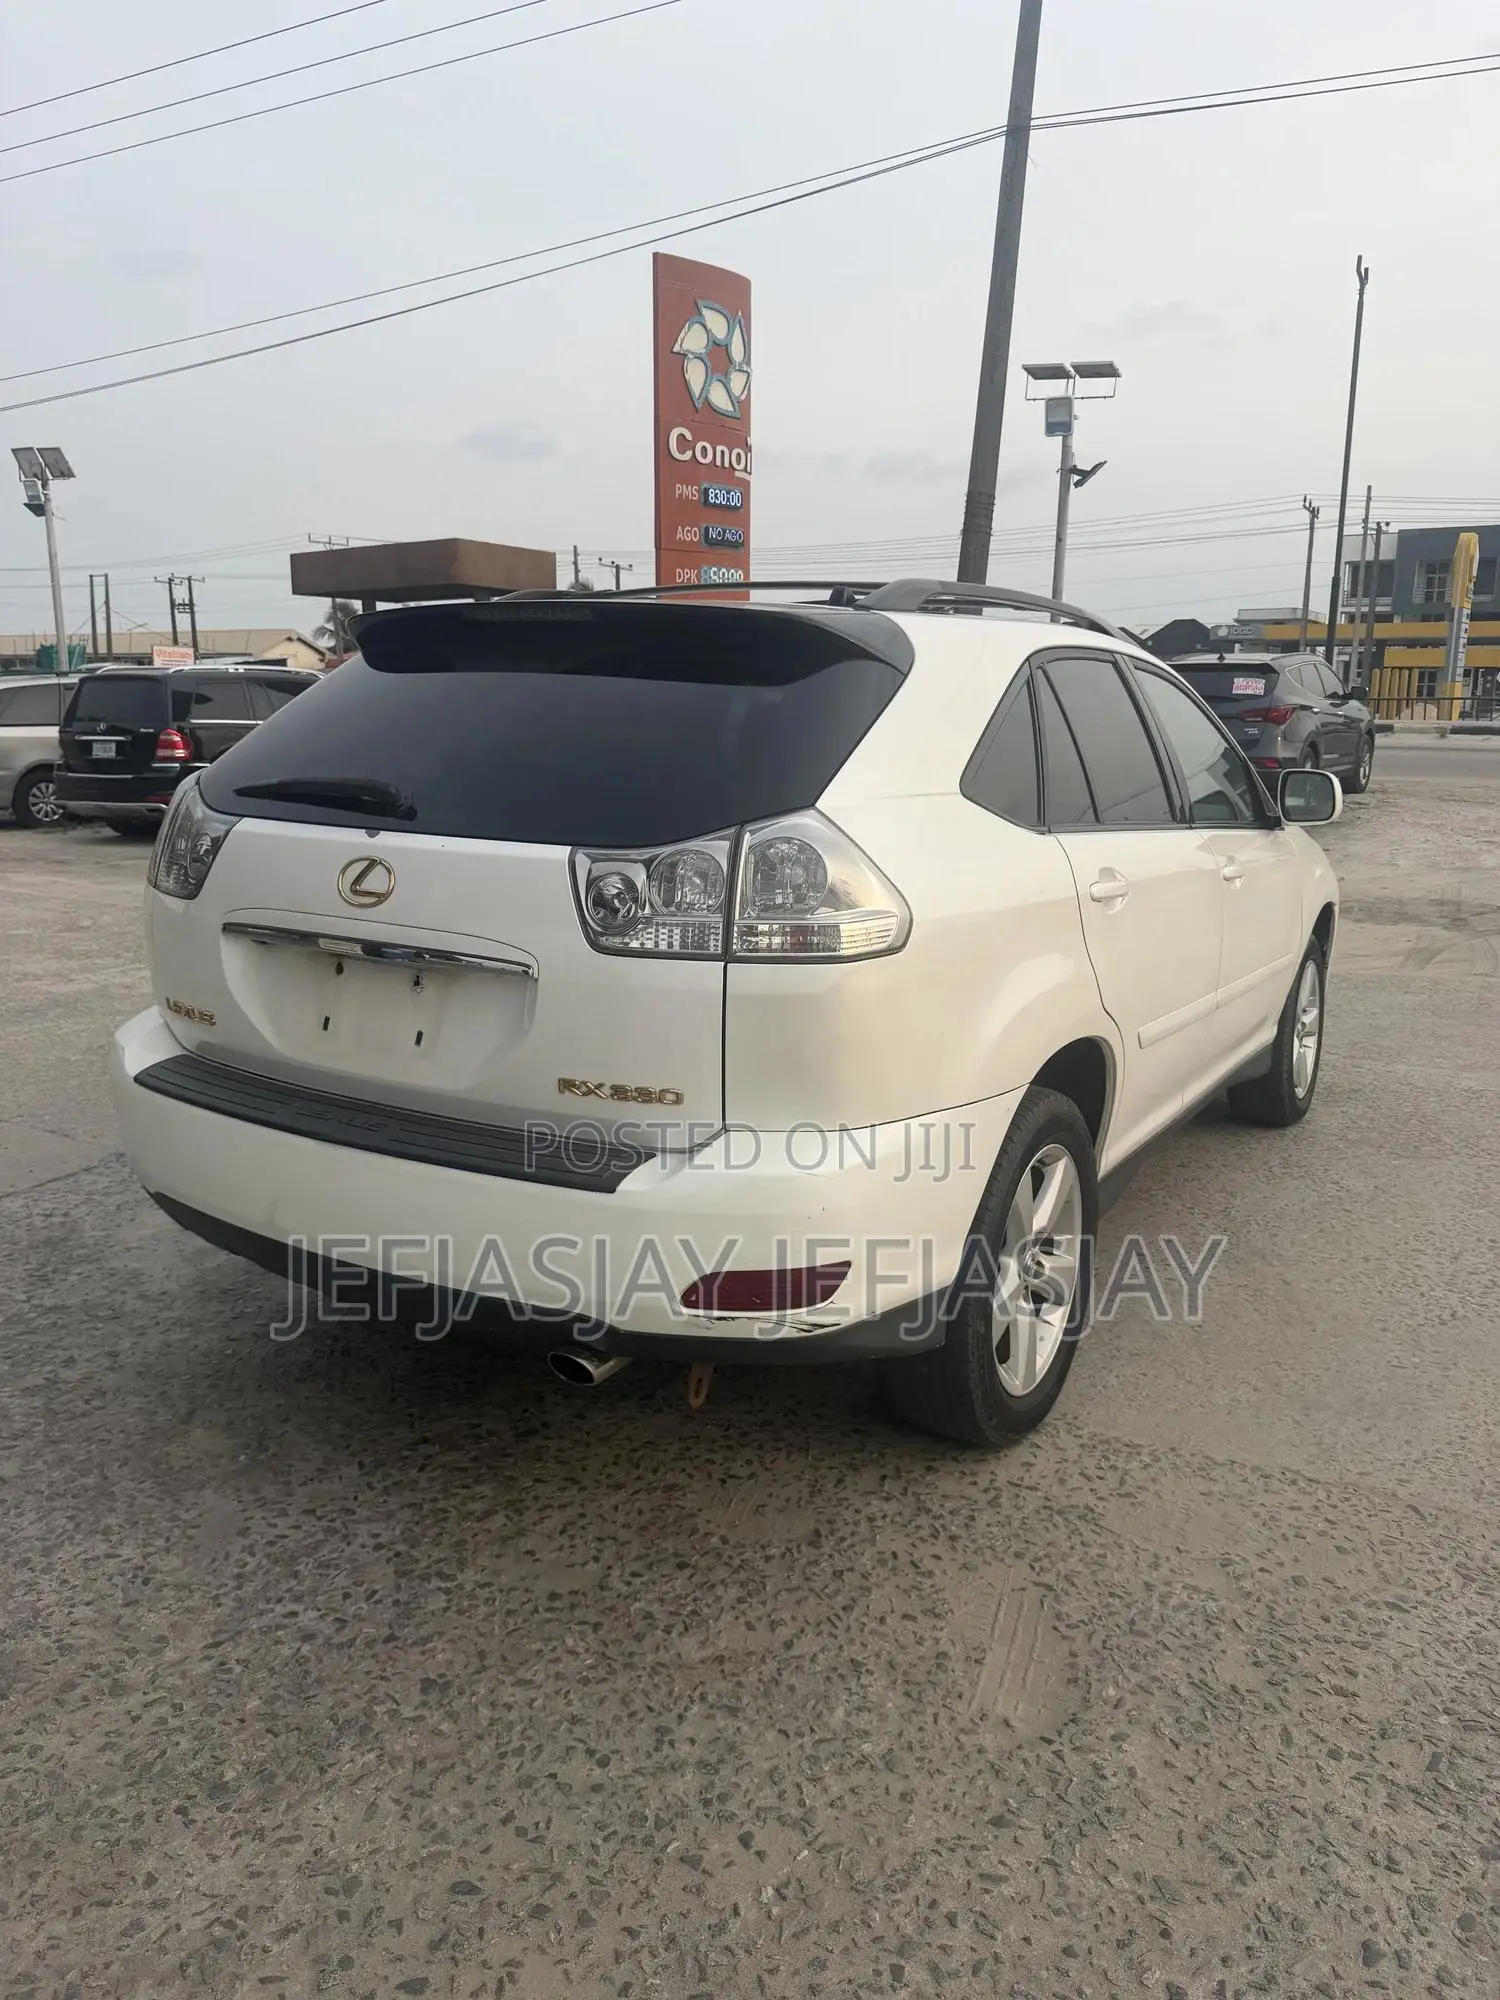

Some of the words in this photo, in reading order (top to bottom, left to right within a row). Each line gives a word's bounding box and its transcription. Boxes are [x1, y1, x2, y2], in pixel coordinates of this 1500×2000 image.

[675, 483, 699, 500] PMS
[708, 488, 742, 506] 830:00
[676, 526, 699, 542] AGO
[709, 527, 723, 540] NO
[725, 530, 743, 543] AGO
[675, 567, 698, 584] DPK
